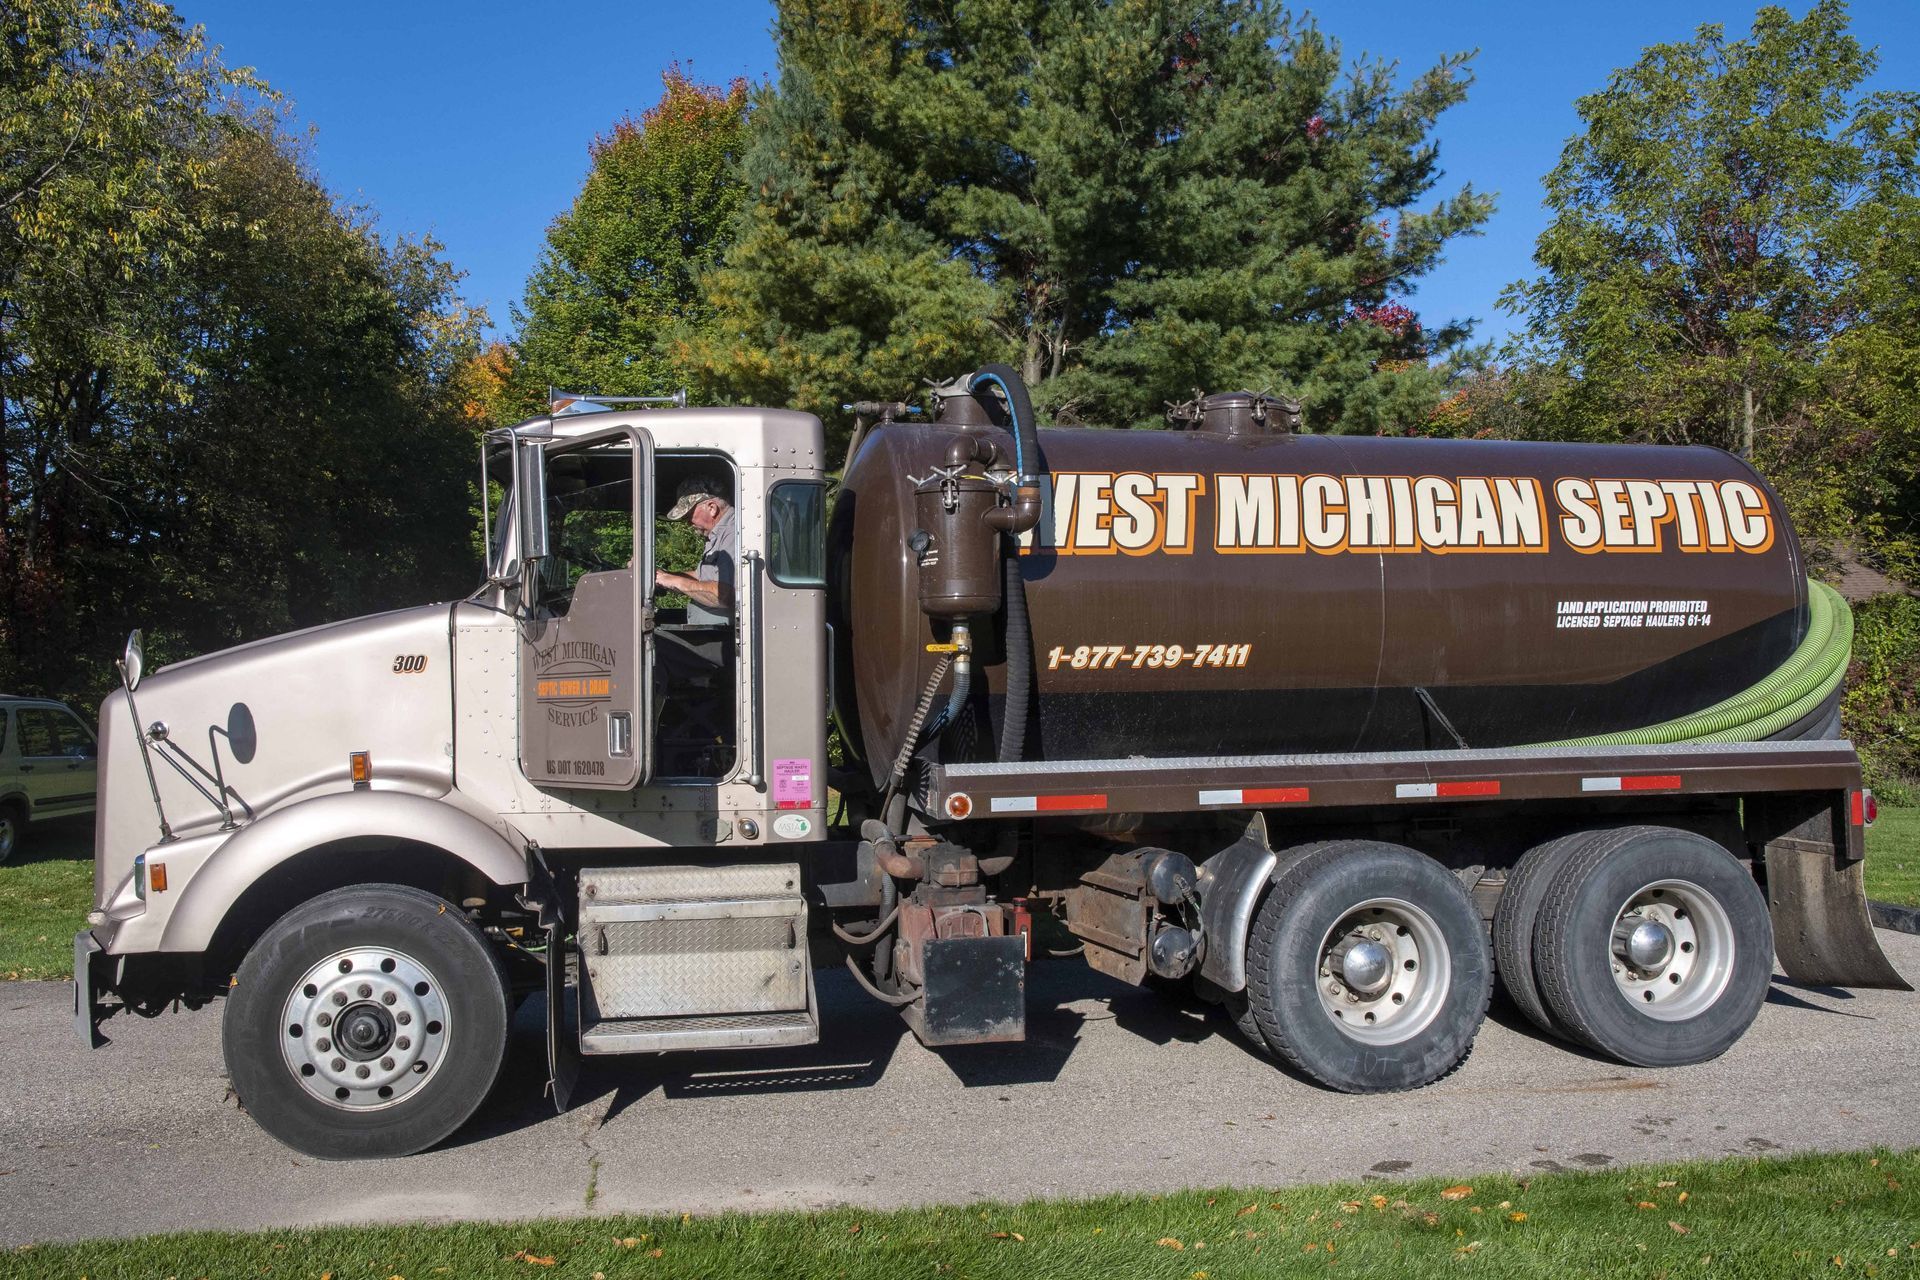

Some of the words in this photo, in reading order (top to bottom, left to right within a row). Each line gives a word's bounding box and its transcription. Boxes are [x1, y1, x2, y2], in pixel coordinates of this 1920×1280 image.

[1214, 473, 1549, 555] MICHIGAN
[1553, 477, 1775, 554] SEPTIC
[1557, 601, 1583, 614] LAND
[1584, 601, 1648, 614] APPLICATION
[1649, 600, 1708, 613] PROHIBITED
[1556, 615, 1600, 628] LICENSED
[1603, 615, 1643, 628] SEPTAGE
[1645, 614, 1686, 627] HAULERS
[1687, 614, 1711, 627] 61-14
[392, 655, 428, 674] 300
[532, 644, 559, 671] WEST
[562, 641, 616, 668] MICHIGAN
[1048, 643, 1252, 670] 1-877-739-7411
[538, 680, 558, 697] SEPTIC
[559, 680, 580, 696] SEWER
[589, 679, 609, 696] DRAIN
[548, 706, 598, 728] SERVICE
[546, 760, 556, 774] US
[557, 760, 571, 775] DOT
[573, 761, 605, 776] 1620478
